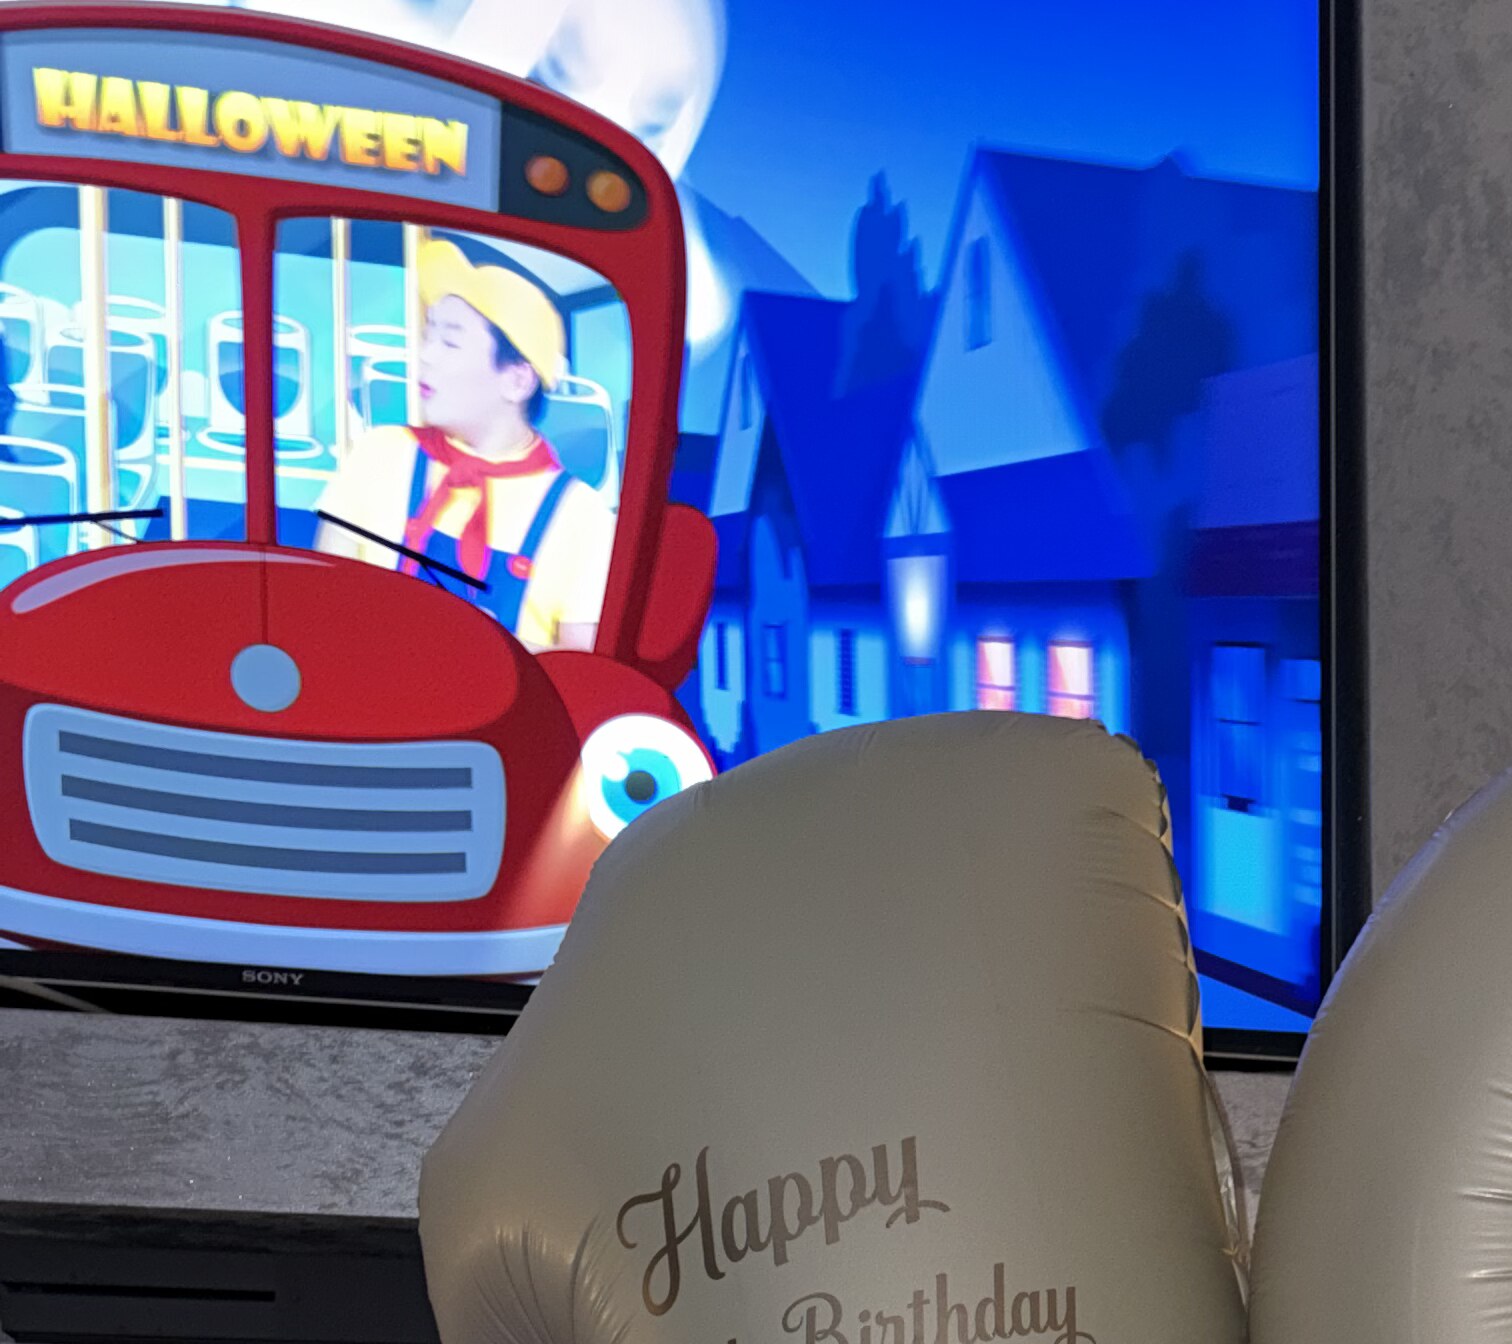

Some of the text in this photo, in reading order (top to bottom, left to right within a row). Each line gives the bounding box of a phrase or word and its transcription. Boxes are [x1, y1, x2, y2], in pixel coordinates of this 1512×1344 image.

[33, 67, 469, 176] HALLOWEEN
[241, 969, 304, 986] SONY
[616, 1135, 950, 1316] Happy
